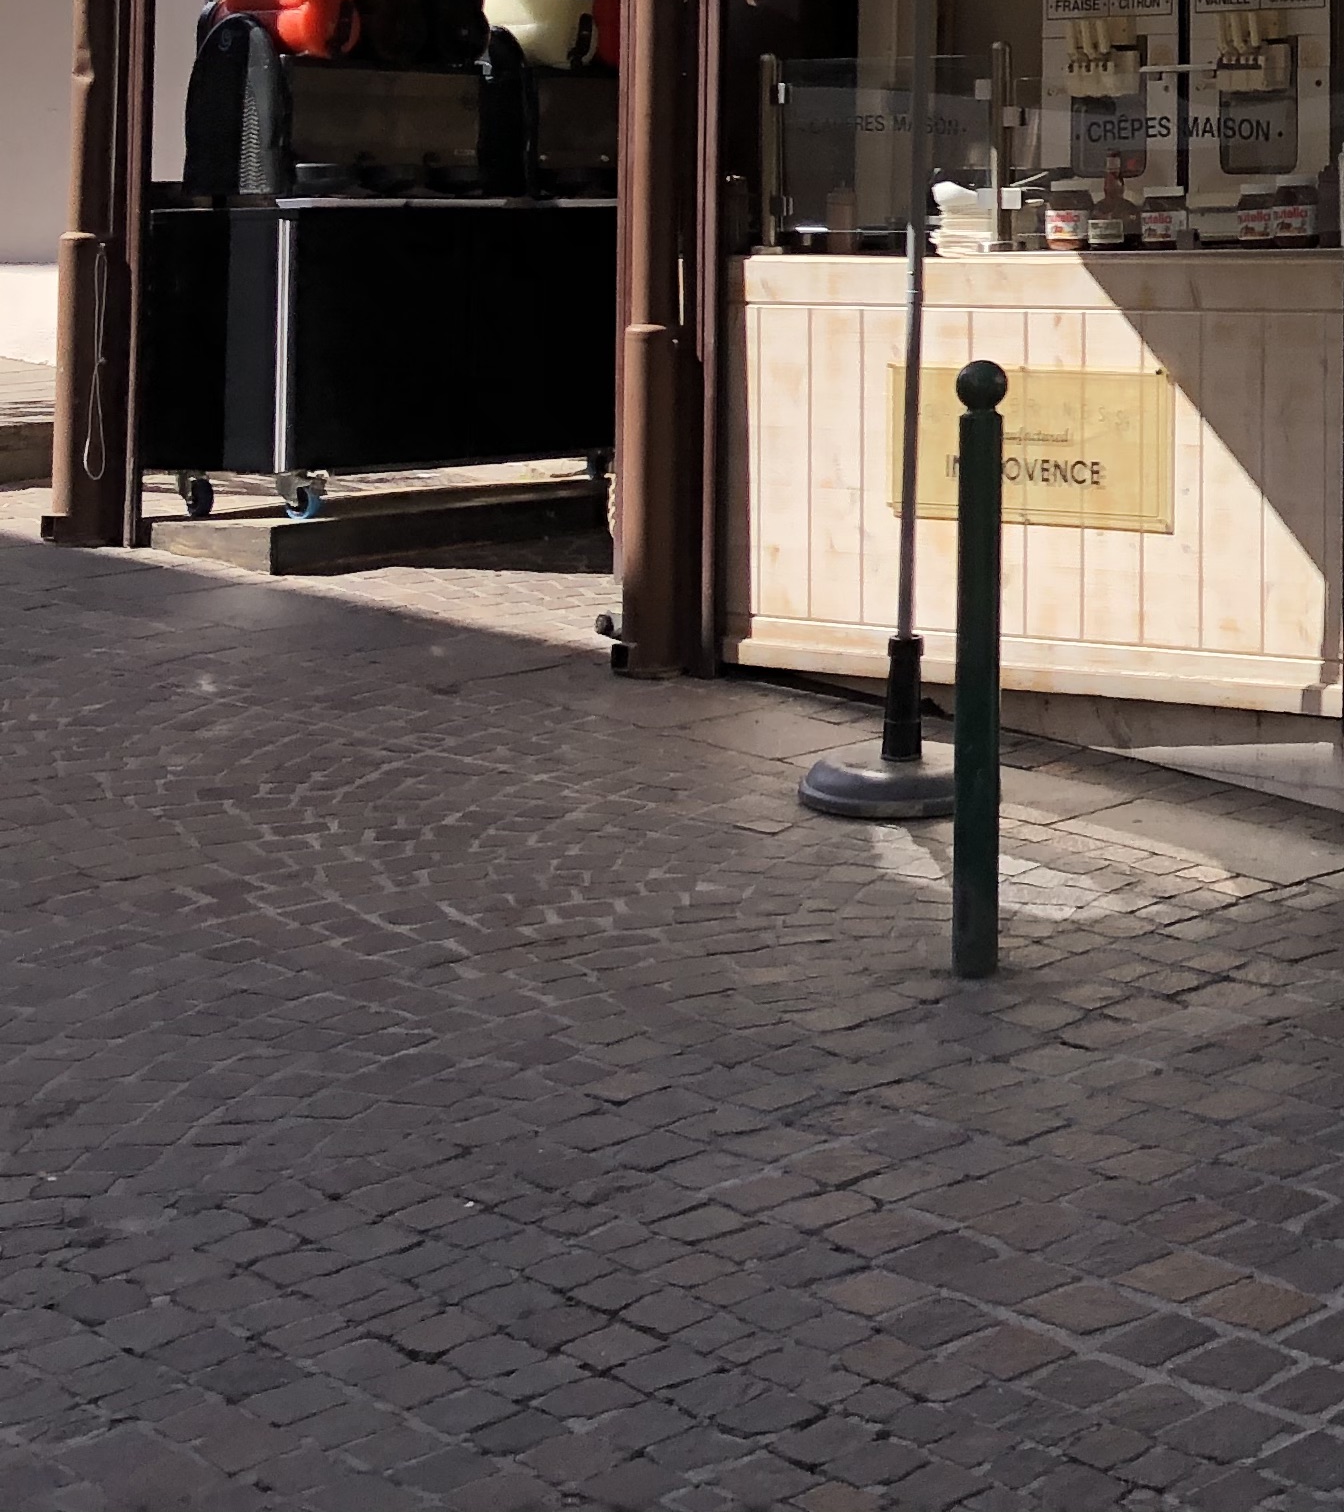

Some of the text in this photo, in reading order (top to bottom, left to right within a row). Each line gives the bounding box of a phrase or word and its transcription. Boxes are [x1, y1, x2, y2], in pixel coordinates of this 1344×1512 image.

[893, 114, 959, 136] MASON
[1087, 114, 1271, 143] CRÊPES MAISON
[1002, 456, 1102, 486] OVENCE
